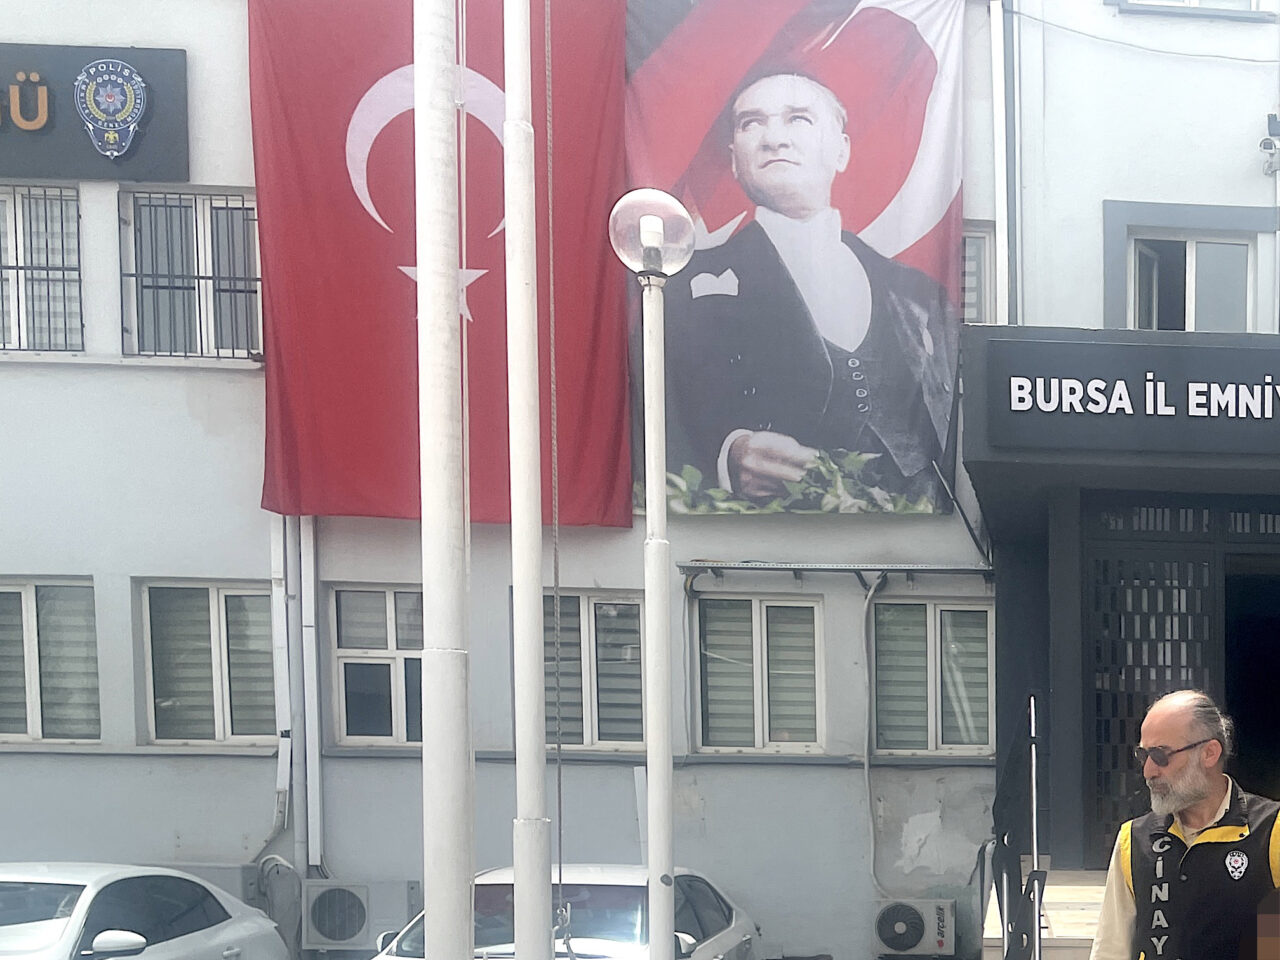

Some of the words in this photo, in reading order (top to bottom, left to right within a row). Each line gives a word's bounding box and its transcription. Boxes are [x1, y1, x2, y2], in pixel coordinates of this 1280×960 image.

[89, 63, 130, 76] POLİS
[0, 71, 48, 130] Ü
[1010, 376, 1133, 414] BURSA
[1145, 372, 1175, 415] İL
